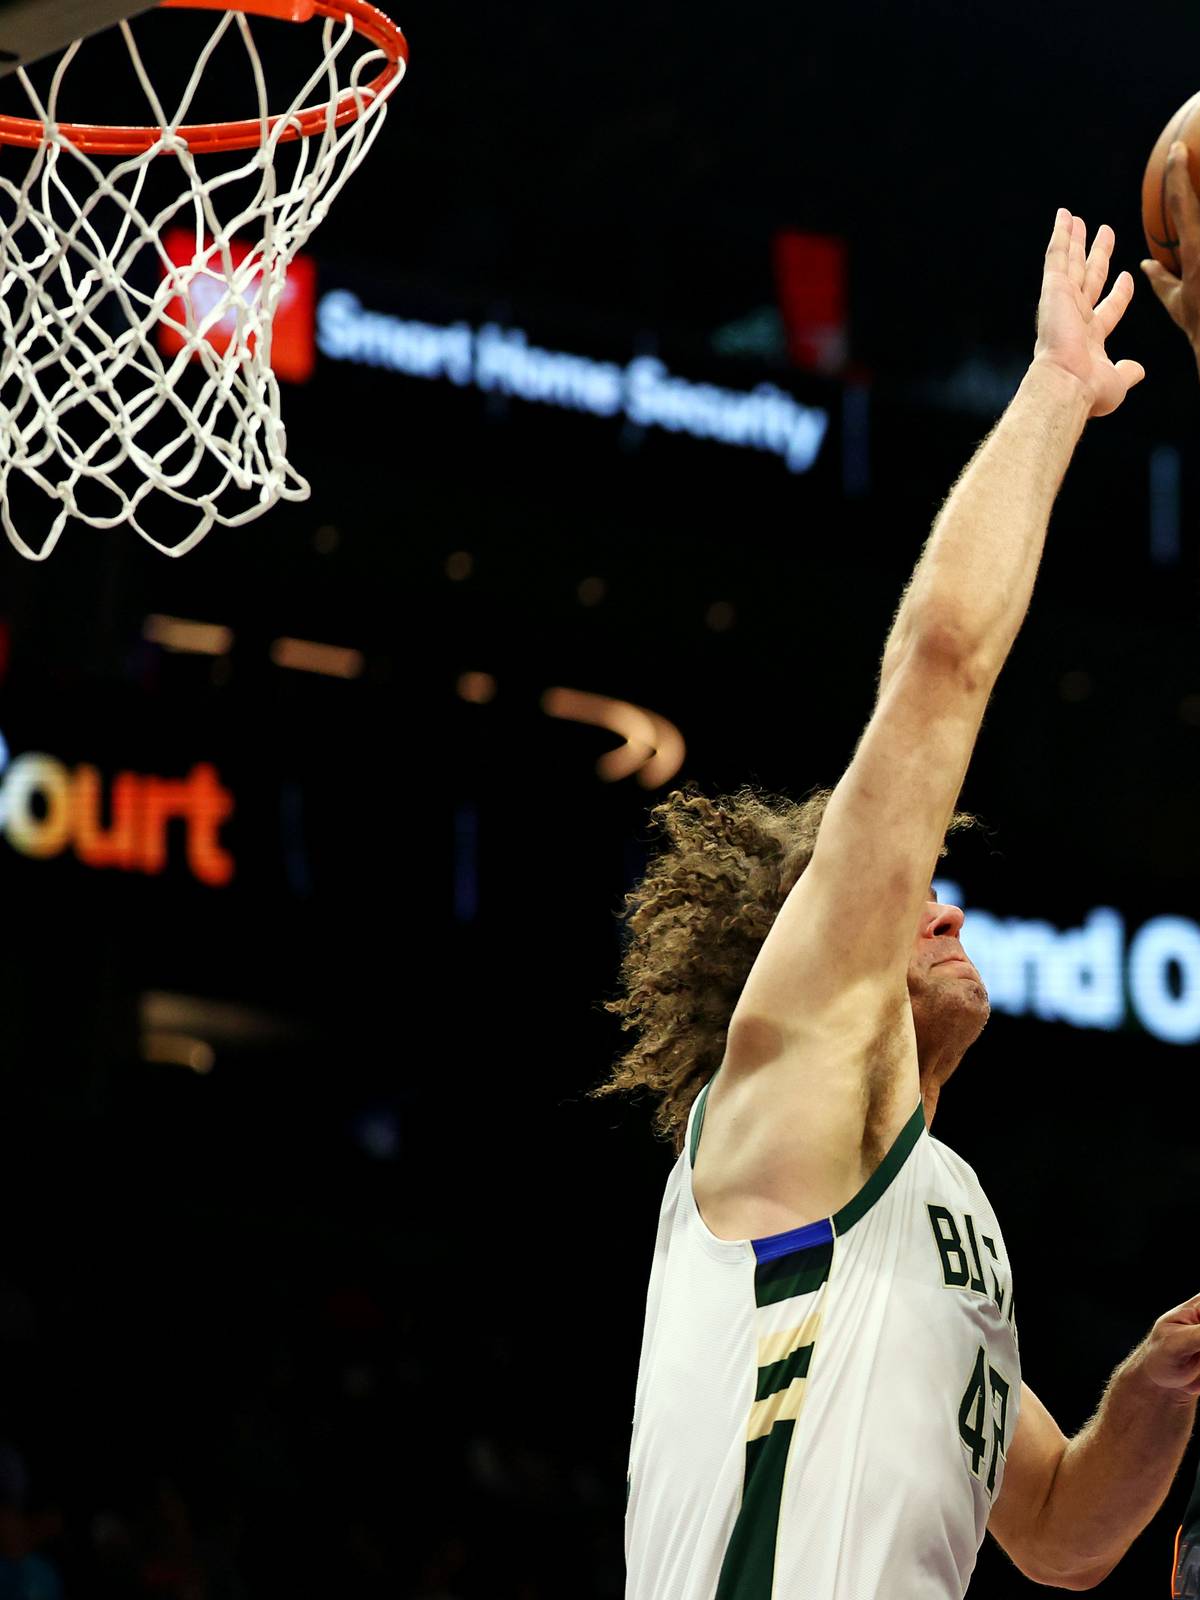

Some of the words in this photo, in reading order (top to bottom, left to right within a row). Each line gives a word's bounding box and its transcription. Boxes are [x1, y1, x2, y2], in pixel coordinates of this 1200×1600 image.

[317, 290, 472, 386] Smart
[476, 322, 622, 417] Home
[624, 355, 827, 473] Security
[0, 738, 235, 886] ourt
